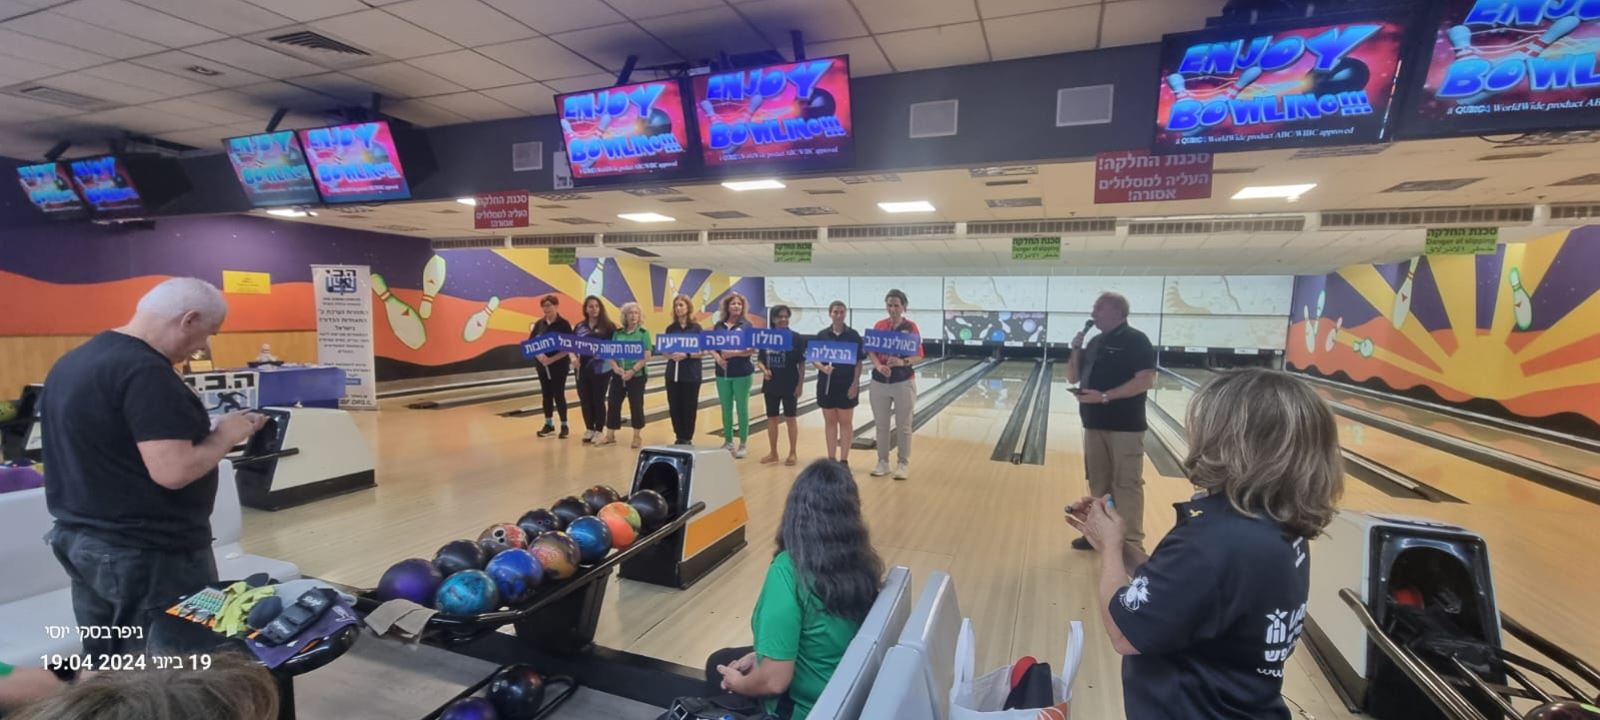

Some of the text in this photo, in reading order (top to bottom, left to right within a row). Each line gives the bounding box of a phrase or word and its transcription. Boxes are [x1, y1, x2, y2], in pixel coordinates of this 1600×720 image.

[1178, 24, 1384, 74] ENJOY
[706, 59, 835, 101] ENJOY
[563, 84, 666, 119] ENJOY
[1545, 100, 1584, 111] product
[307, 123, 380, 149] ENJOY
[1098, 153, 1160, 173] החלקה!
[1099, 172, 1209, 190] העליה למסלולים
[1128, 188, 1177, 202] אסורה!
[1469, 227, 1497, 236] סכנת
[524, 338, 556, 354] רחובות
[558, 335, 572, 348] בול
[657, 335, 699, 351] מודיעין
[706, 334, 740, 346] חיפה
[751, 330, 784, 346] חולון
[865, 335, 917, 352] באולינג נגב
[600, 344, 643, 356] פתח תקווה
[811, 344, 852, 360] הרצליה
